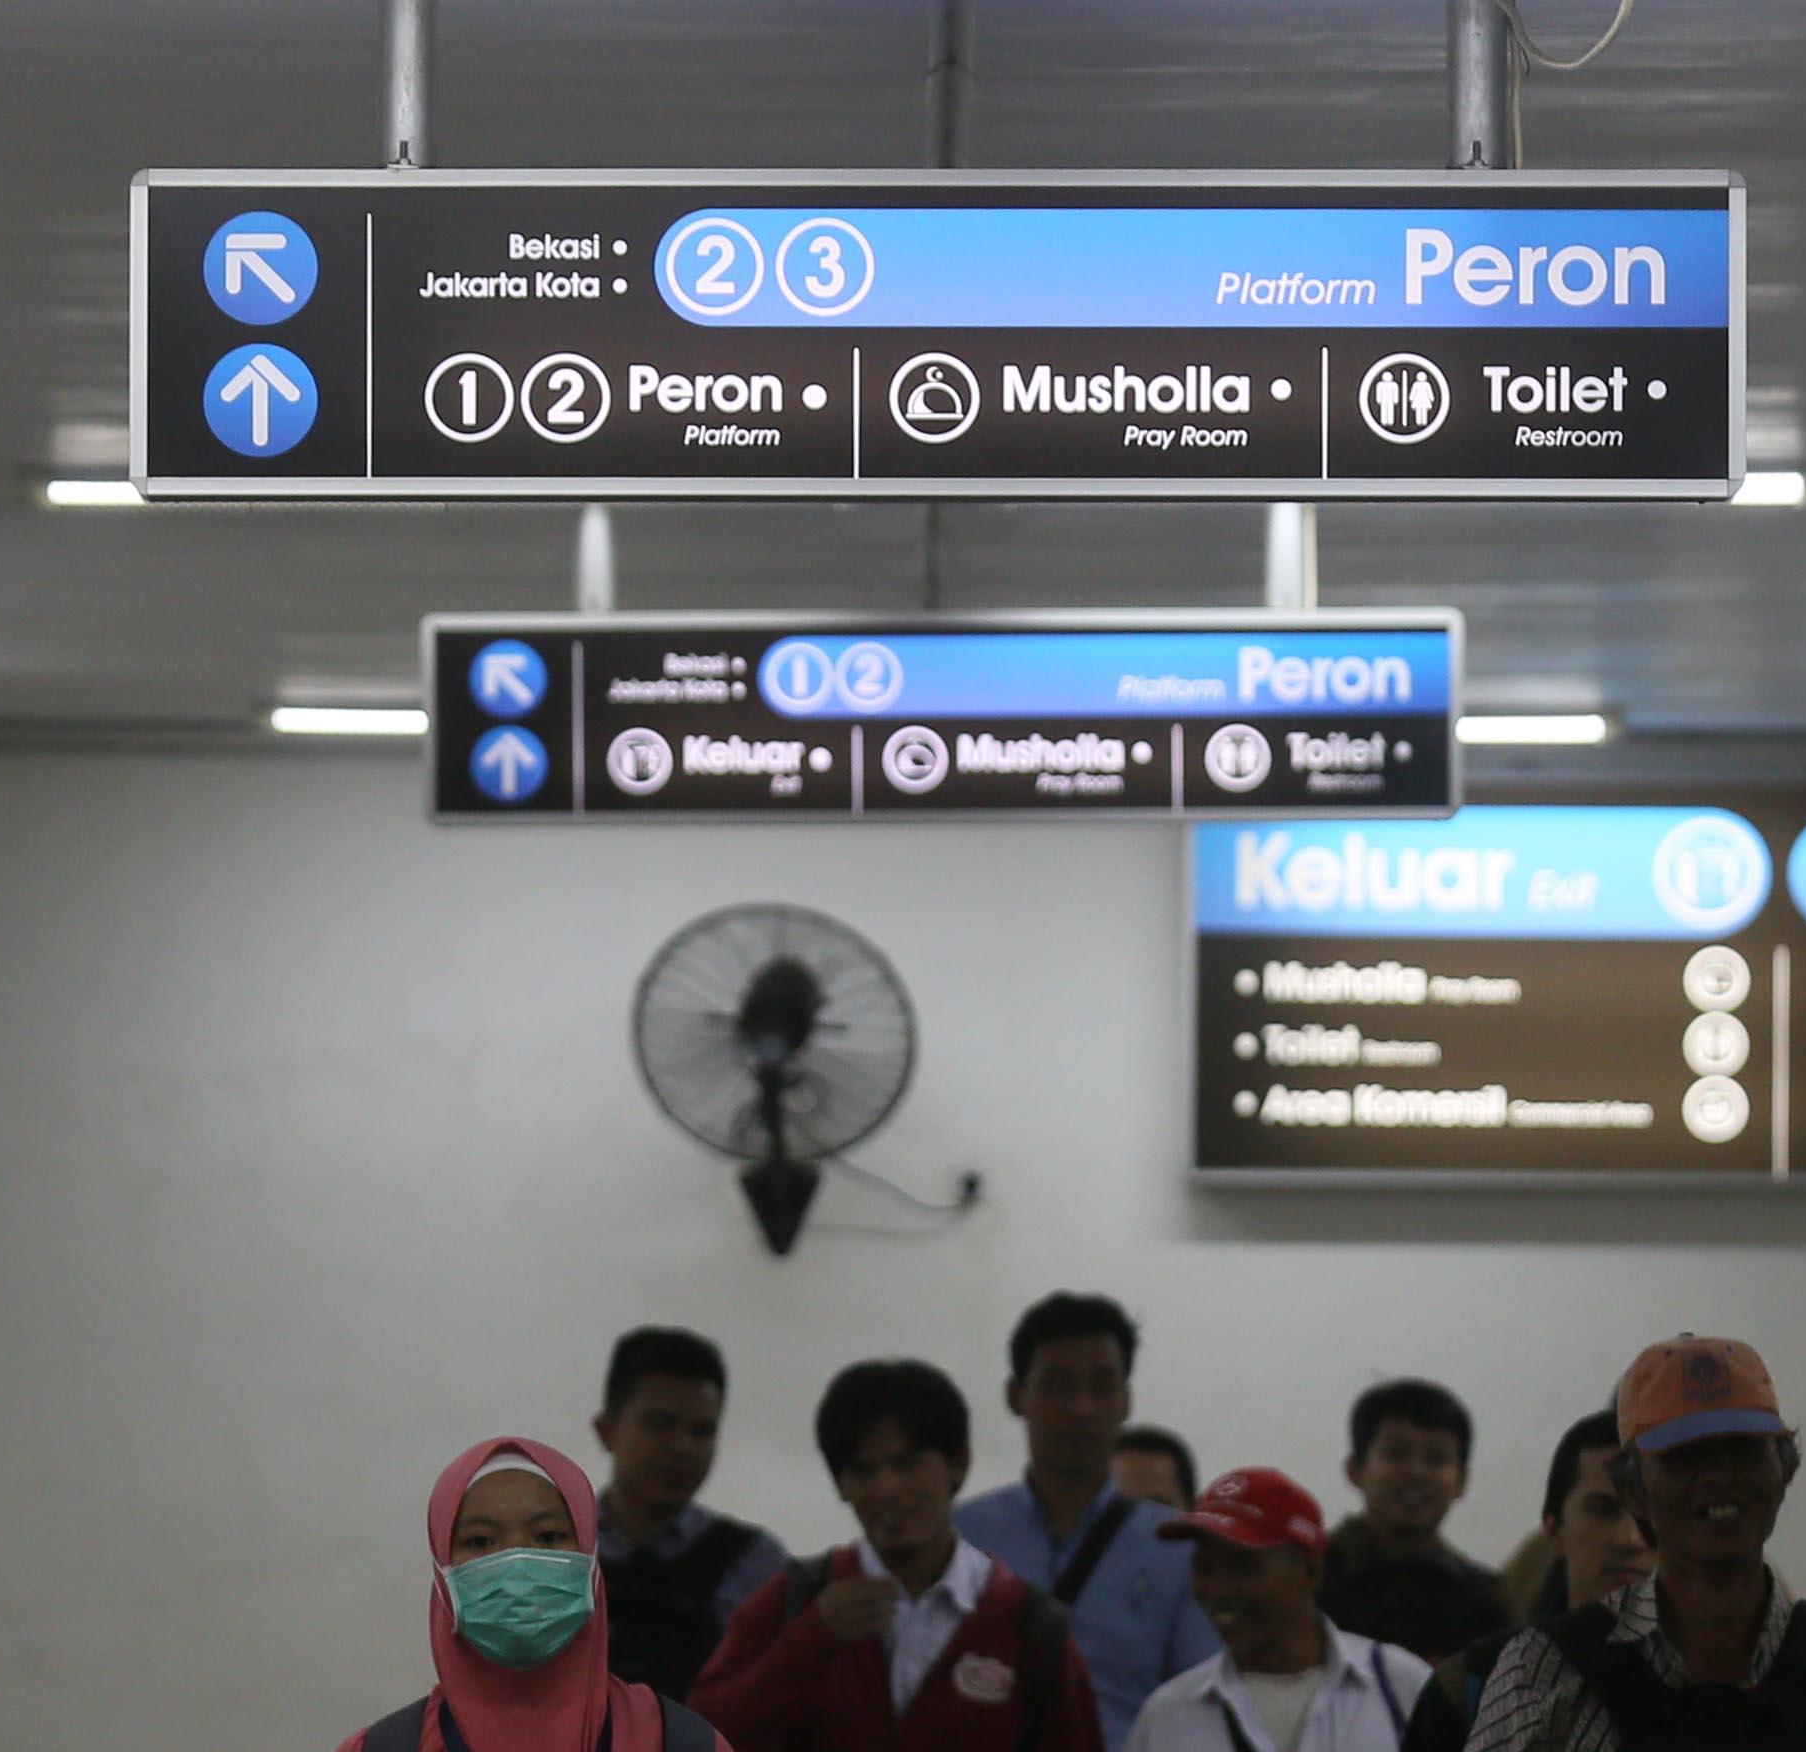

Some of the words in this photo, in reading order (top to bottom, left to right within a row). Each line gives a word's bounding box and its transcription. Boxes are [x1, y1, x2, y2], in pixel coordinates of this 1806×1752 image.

[510, 234, 599, 259] Bekasi
[1216, 272, 1375, 305] Platform
[1405, 228, 1665, 306] Peron
[420, 272, 527, 297] Jakarta
[536, 272, 599, 298] Kota
[630, 365, 782, 412] Peron
[1003, 366, 1249, 413] Musholla
[1483, 367, 1627, 413] Toilet
[685, 425, 780, 445] Platform
[1124, 426, 1175, 449] Pray
[1181, 426, 1247, 446] Room
[1516, 426, 1622, 446] Restroom
[1237, 646, 1411, 705] Peron
[683, 735, 804, 777] Keluar
[957, 733, 1125, 775] Musholla
[1287, 732, 1385, 772] Toilet
[1238, 831, 1520, 915] Keluar
[1264, 961, 1427, 1003] Musholla
[1261, 1023, 1361, 1065] Toilet
[1262, 1085, 1352, 1125] Area
[1353, 1084, 1509, 1126] Komersil
